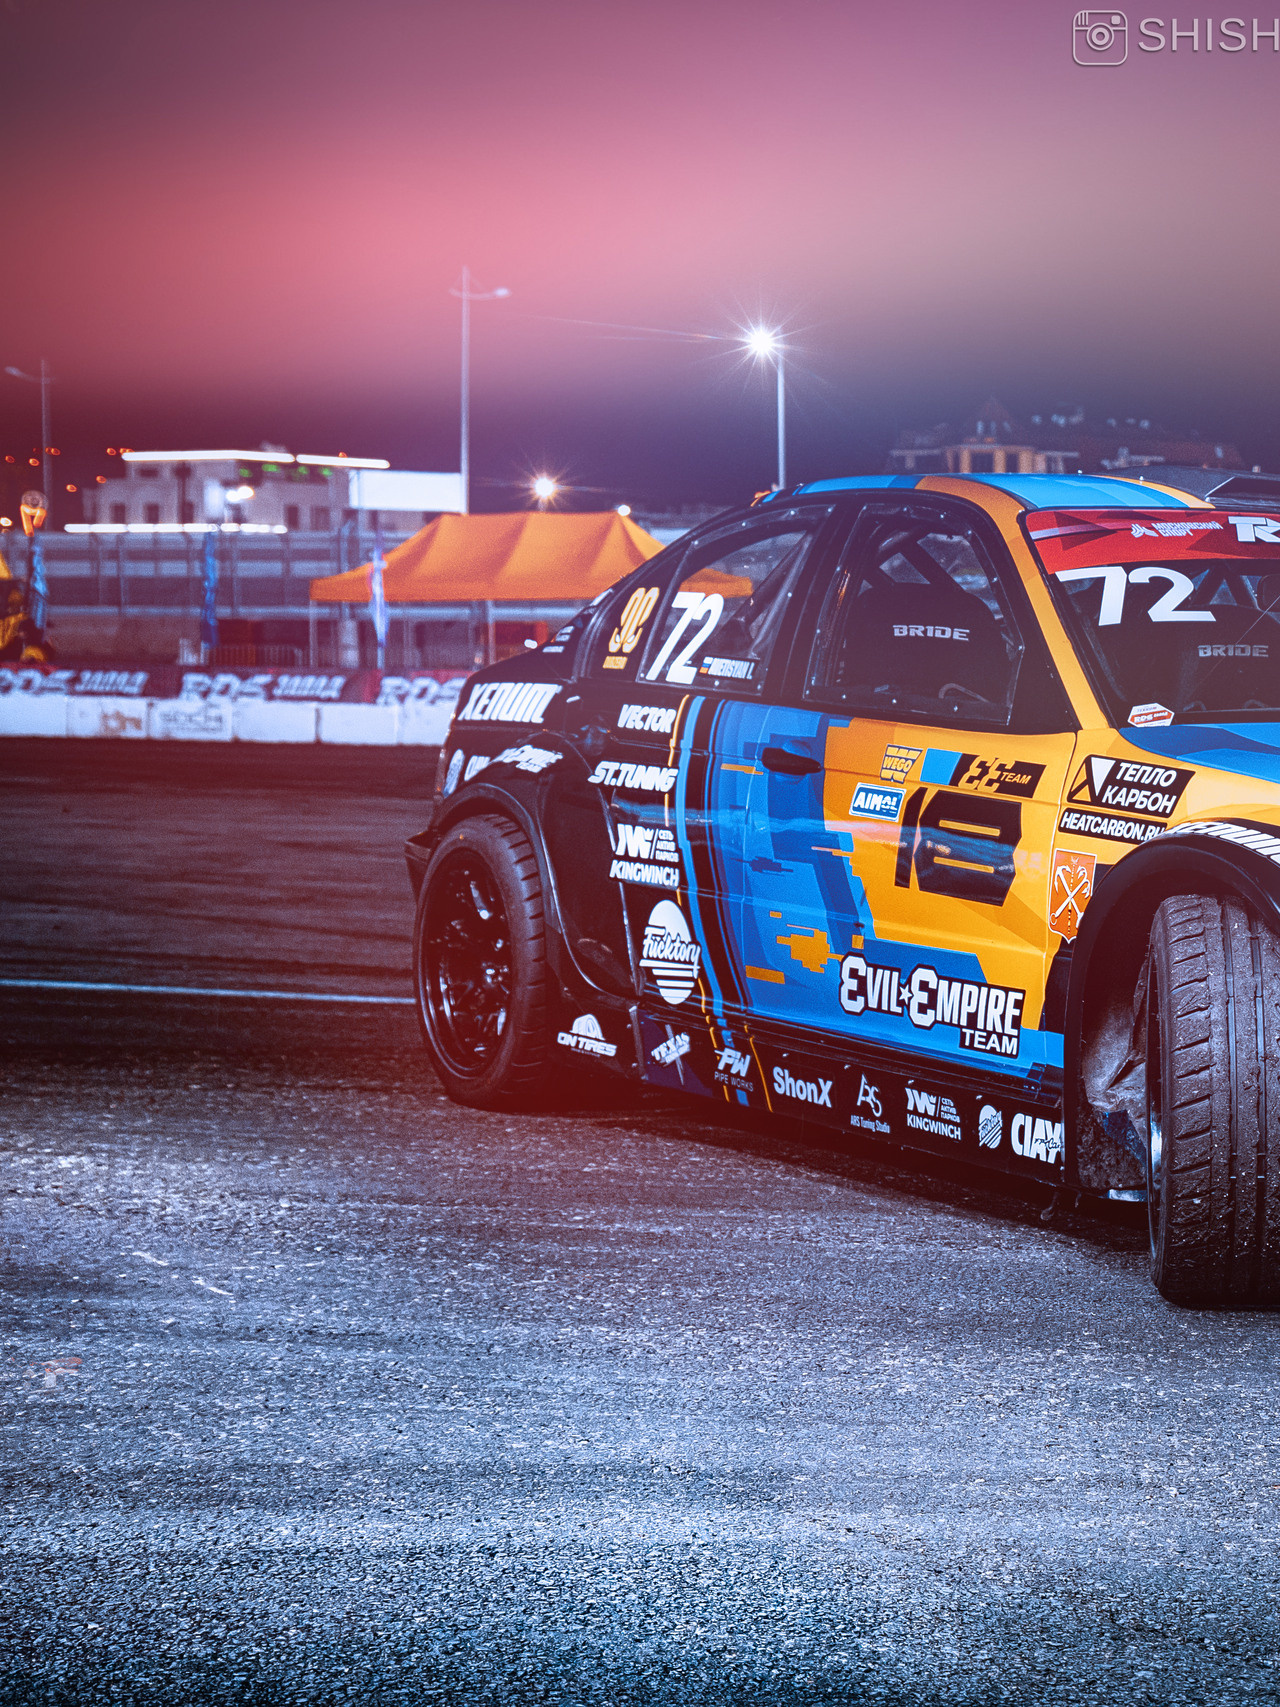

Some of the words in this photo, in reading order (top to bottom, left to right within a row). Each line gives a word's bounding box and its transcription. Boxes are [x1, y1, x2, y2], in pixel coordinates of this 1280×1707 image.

[1055, 566, 1216, 627] 72
[645, 591, 724, 685] 72
[893, 624, 970, 641] BRIDE
[1198, 644, 1269, 658] BRIDE
[457, 682, 563, 724] XENUM
[617, 704, 677, 733] VECTOR
[882, 756, 914, 772] WEGO
[999, 771, 1032, 785] TEAM
[1114, 761, 1177, 788] ТЕПЛО
[853, 791, 899, 814] AIMOL
[1101, 784, 1178, 815] КАРБОН
[609, 859, 680, 888] KINGWINCH
[841, 955, 903, 1014] EVIL
[909, 967, 1024, 1037] EMPIRE
[557, 1031, 578, 1047] ON
[577, 1036, 618, 1057] TIRES
[961, 1027, 1018, 1056] TEAM
[713, 1071, 729, 1085] PIPE
[730, 1077, 754, 1092] WORKS
[772, 1066, 833, 1108] ShonX
[906, 1113, 962, 1141] KINGWINCH
